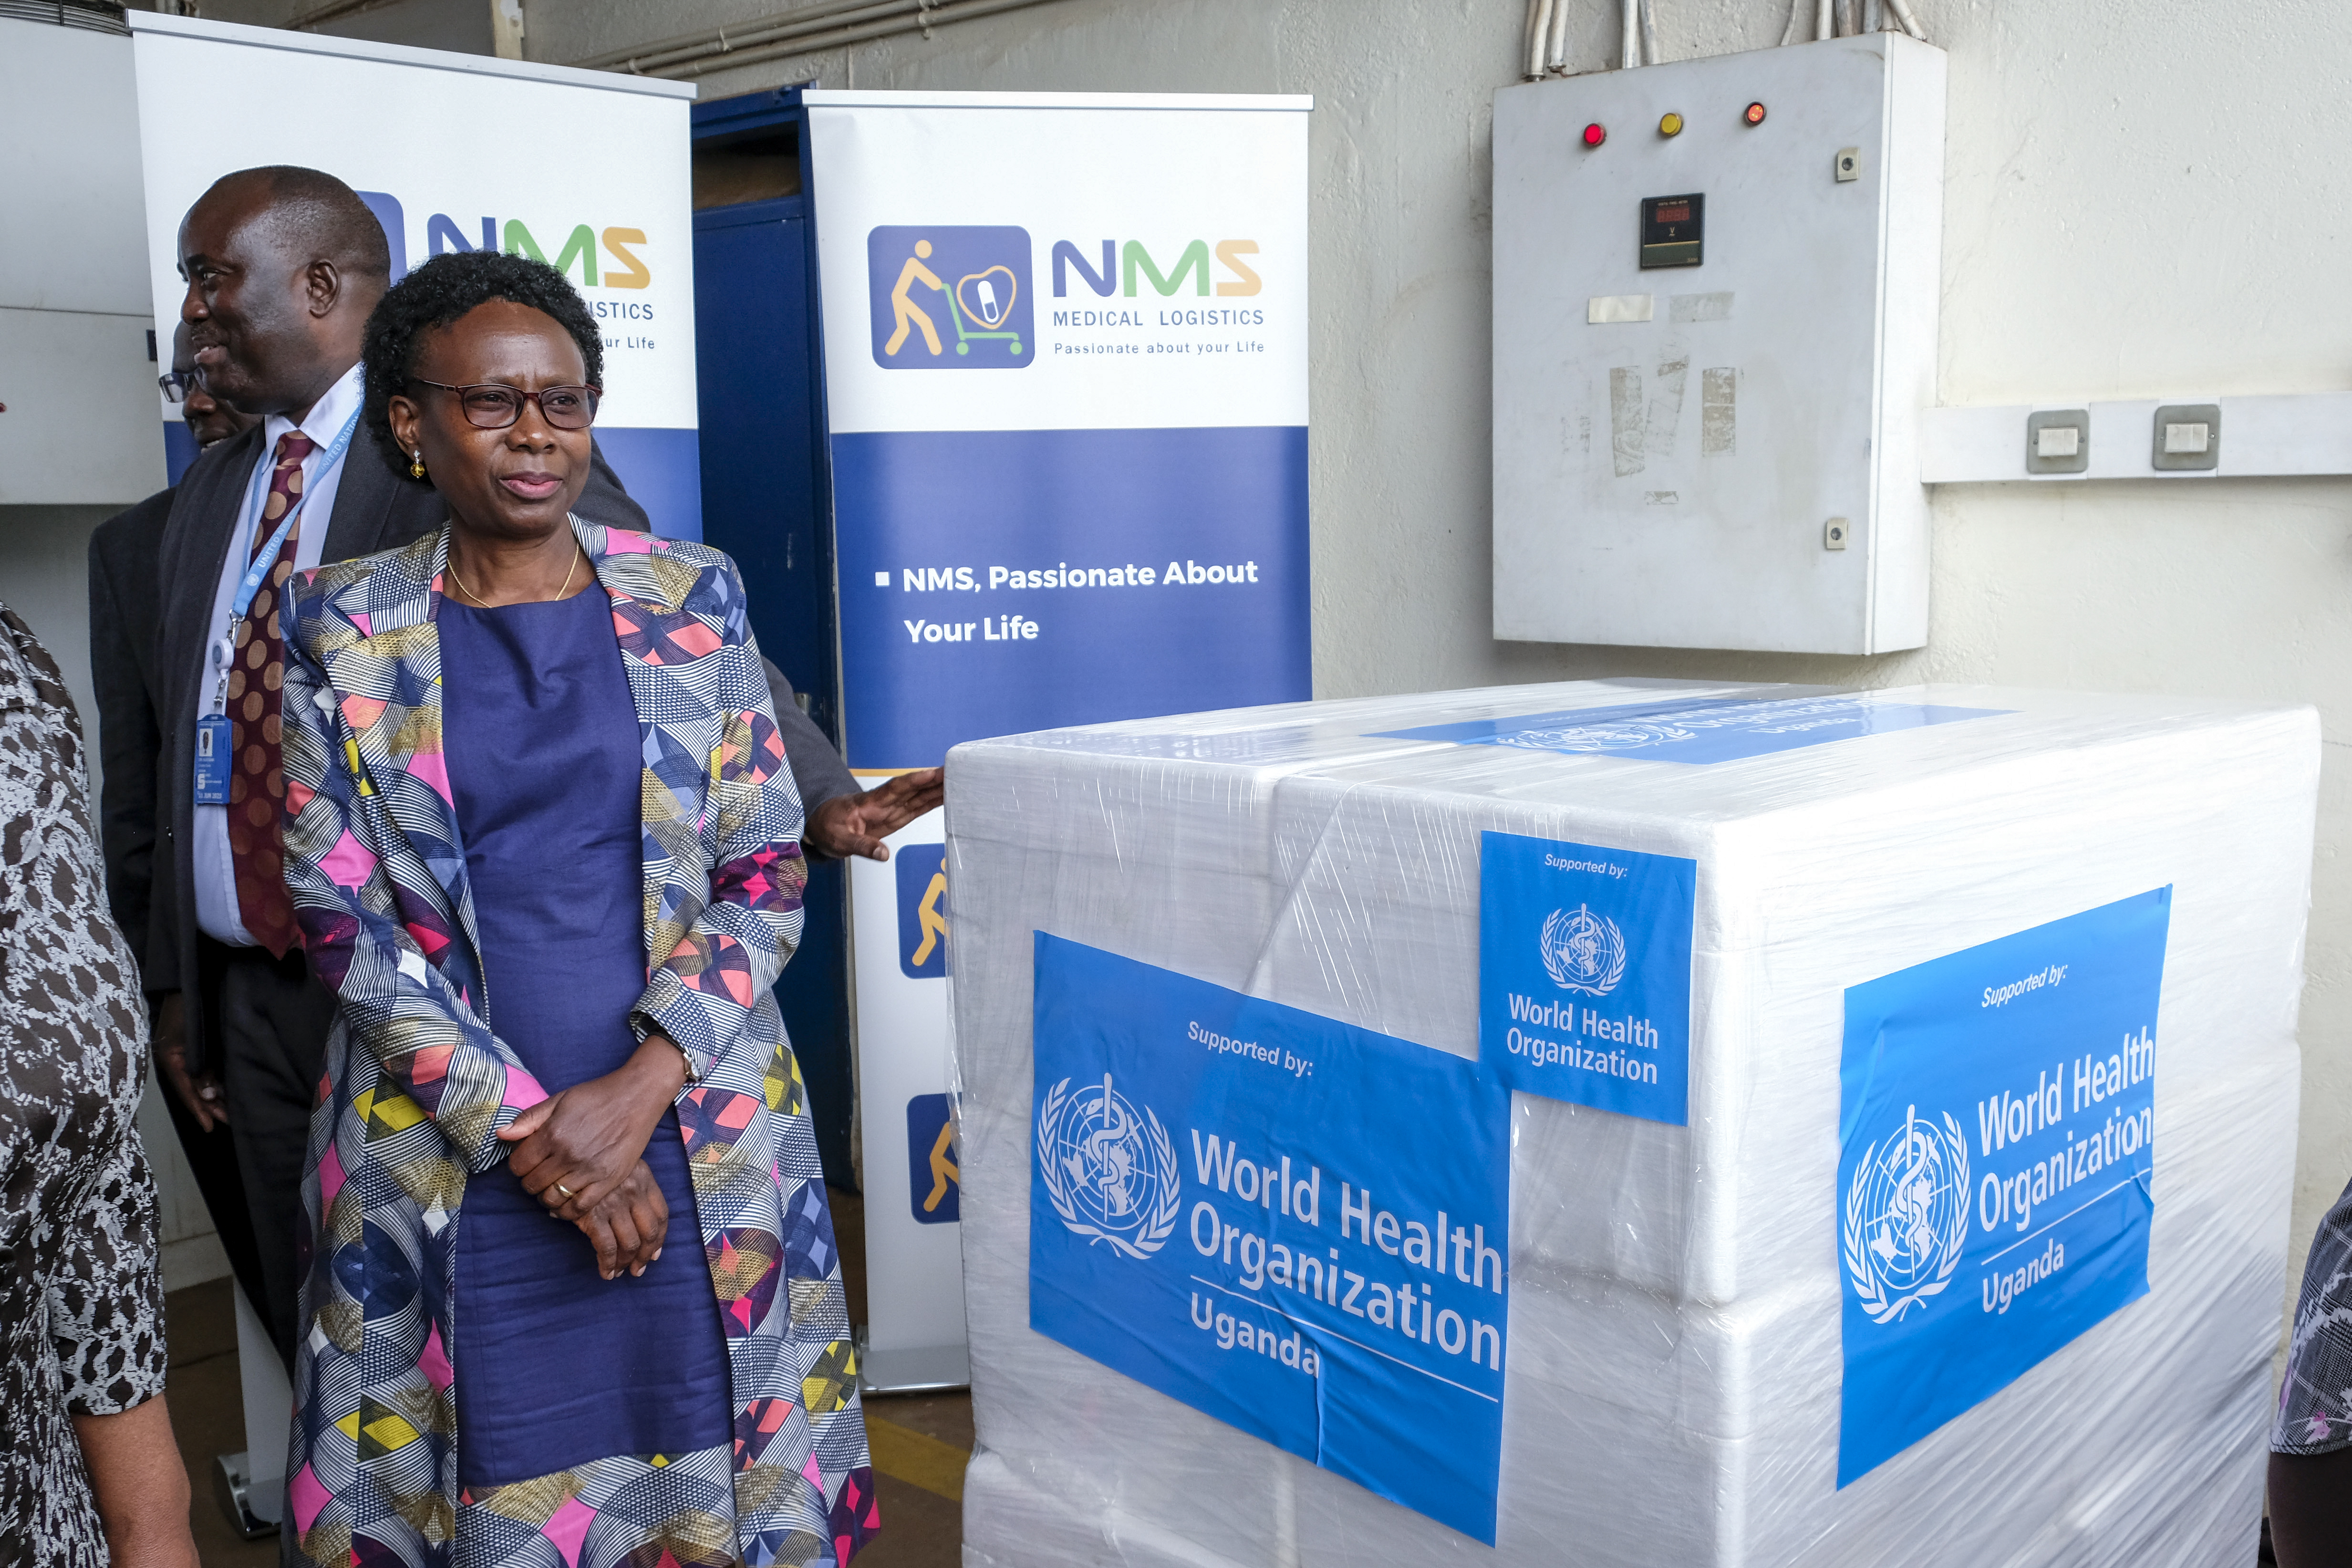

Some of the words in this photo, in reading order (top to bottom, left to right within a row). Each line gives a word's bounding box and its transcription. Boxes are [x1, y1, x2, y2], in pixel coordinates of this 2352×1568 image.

[427, 213, 650, 289] NMS
[1052, 239, 1263, 297] NMS
[589, 301, 653, 320] ISTICS
[1053, 311, 1143, 326] MEDICAL
[1160, 310, 1264, 325] LOGISTICS
[606, 338, 620, 348] ur
[627, 337, 654, 349] Life
[1055, 343, 1139, 354] Passionate
[1147, 342, 1190, 353] about
[1197, 343, 1229, 355] your
[1237, 341, 1264, 353] Life
[258, 537, 280, 568] UNITED
[902, 567, 981, 593] NMS,
[989, 562, 1156, 589] Passionate
[1163, 560, 1258, 585] About
[904, 619, 975, 643] Your
[984, 615, 1039, 641] Life
[1544, 854, 1606, 874] Supported
[1609, 862, 1627, 879] by:
[1981, 967, 2047, 1008] Supported
[2049, 964, 2068, 986] by:
[1188, 1021, 1280, 1065] Supported
[1284, 1051, 1313, 1077] by:
[1509, 993, 1573, 1031] World
[1583, 1008, 1658, 1049] Health
[1507, 1027, 1658, 1084] Organization
[1979, 1063, 2062, 1157] World
[2073, 1026, 2153, 1113] Health
[1979, 1106, 2152, 1232] Organization
[1191, 1129, 1320, 1226] World
[1341, 1182, 1502, 1295] Health
[1190, 1201, 1501, 1371] Organization
[1982, 1238, 2064, 1315] Uganda
[1191, 1292, 1320, 1378] Uganda
